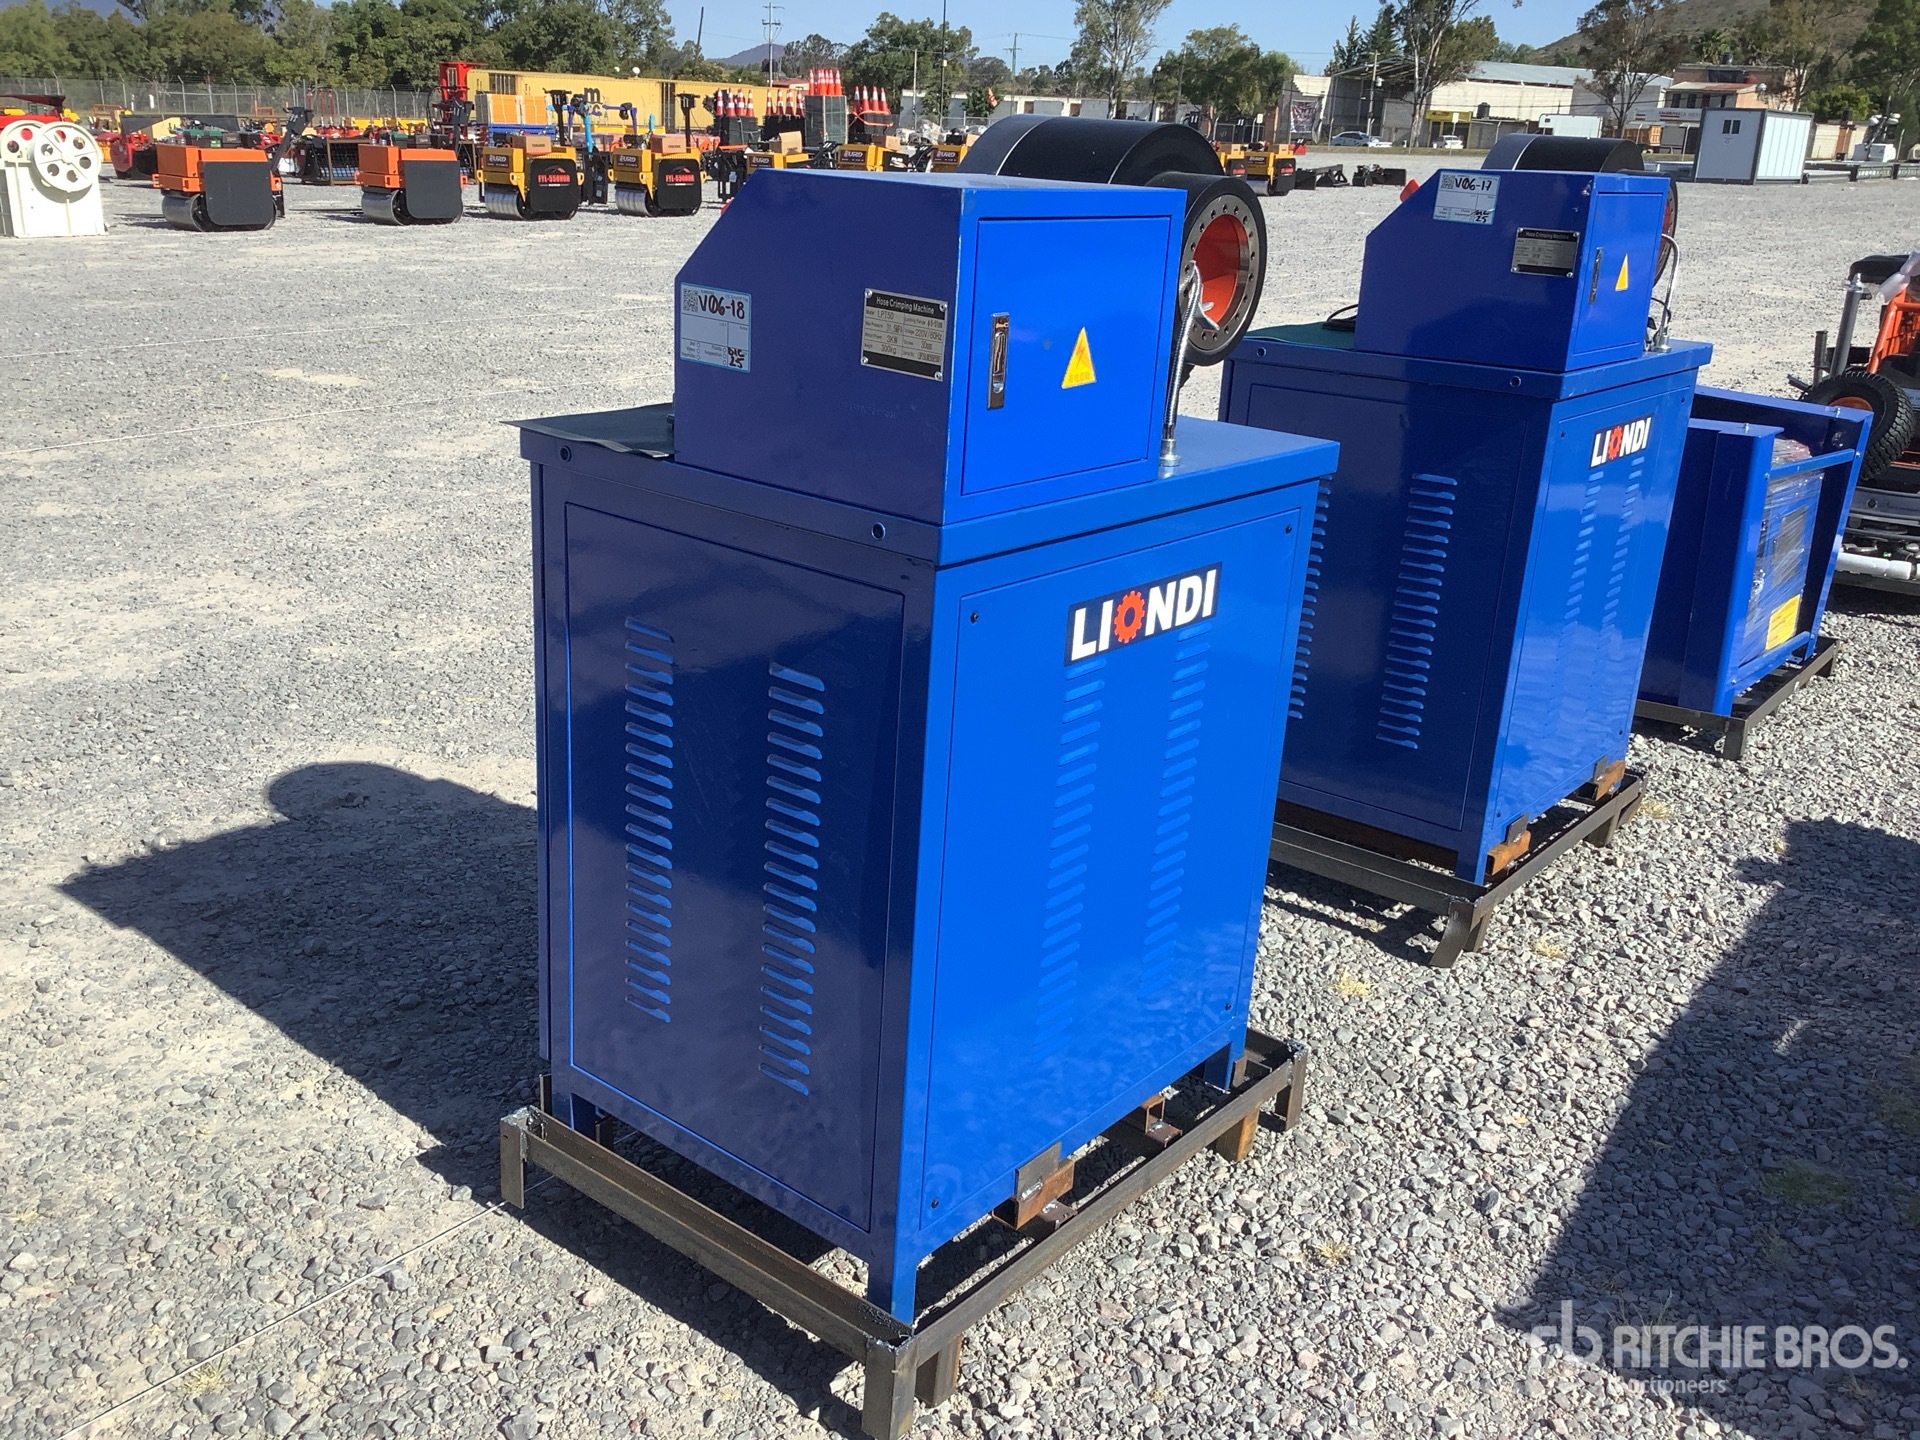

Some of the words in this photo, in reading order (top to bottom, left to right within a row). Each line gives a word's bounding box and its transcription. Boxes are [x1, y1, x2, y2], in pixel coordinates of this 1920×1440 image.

[1455, 177, 1492, 191] V06-17
[698, 294, 745, 319] V06-18
[876, 296, 889, 307] Hose
[889, 298, 912, 312] Crimping
[913, 302, 935, 315] Machine
[1590, 416, 1652, 468] LIONDI
[1071, 568, 1217, 662] LIONDI
